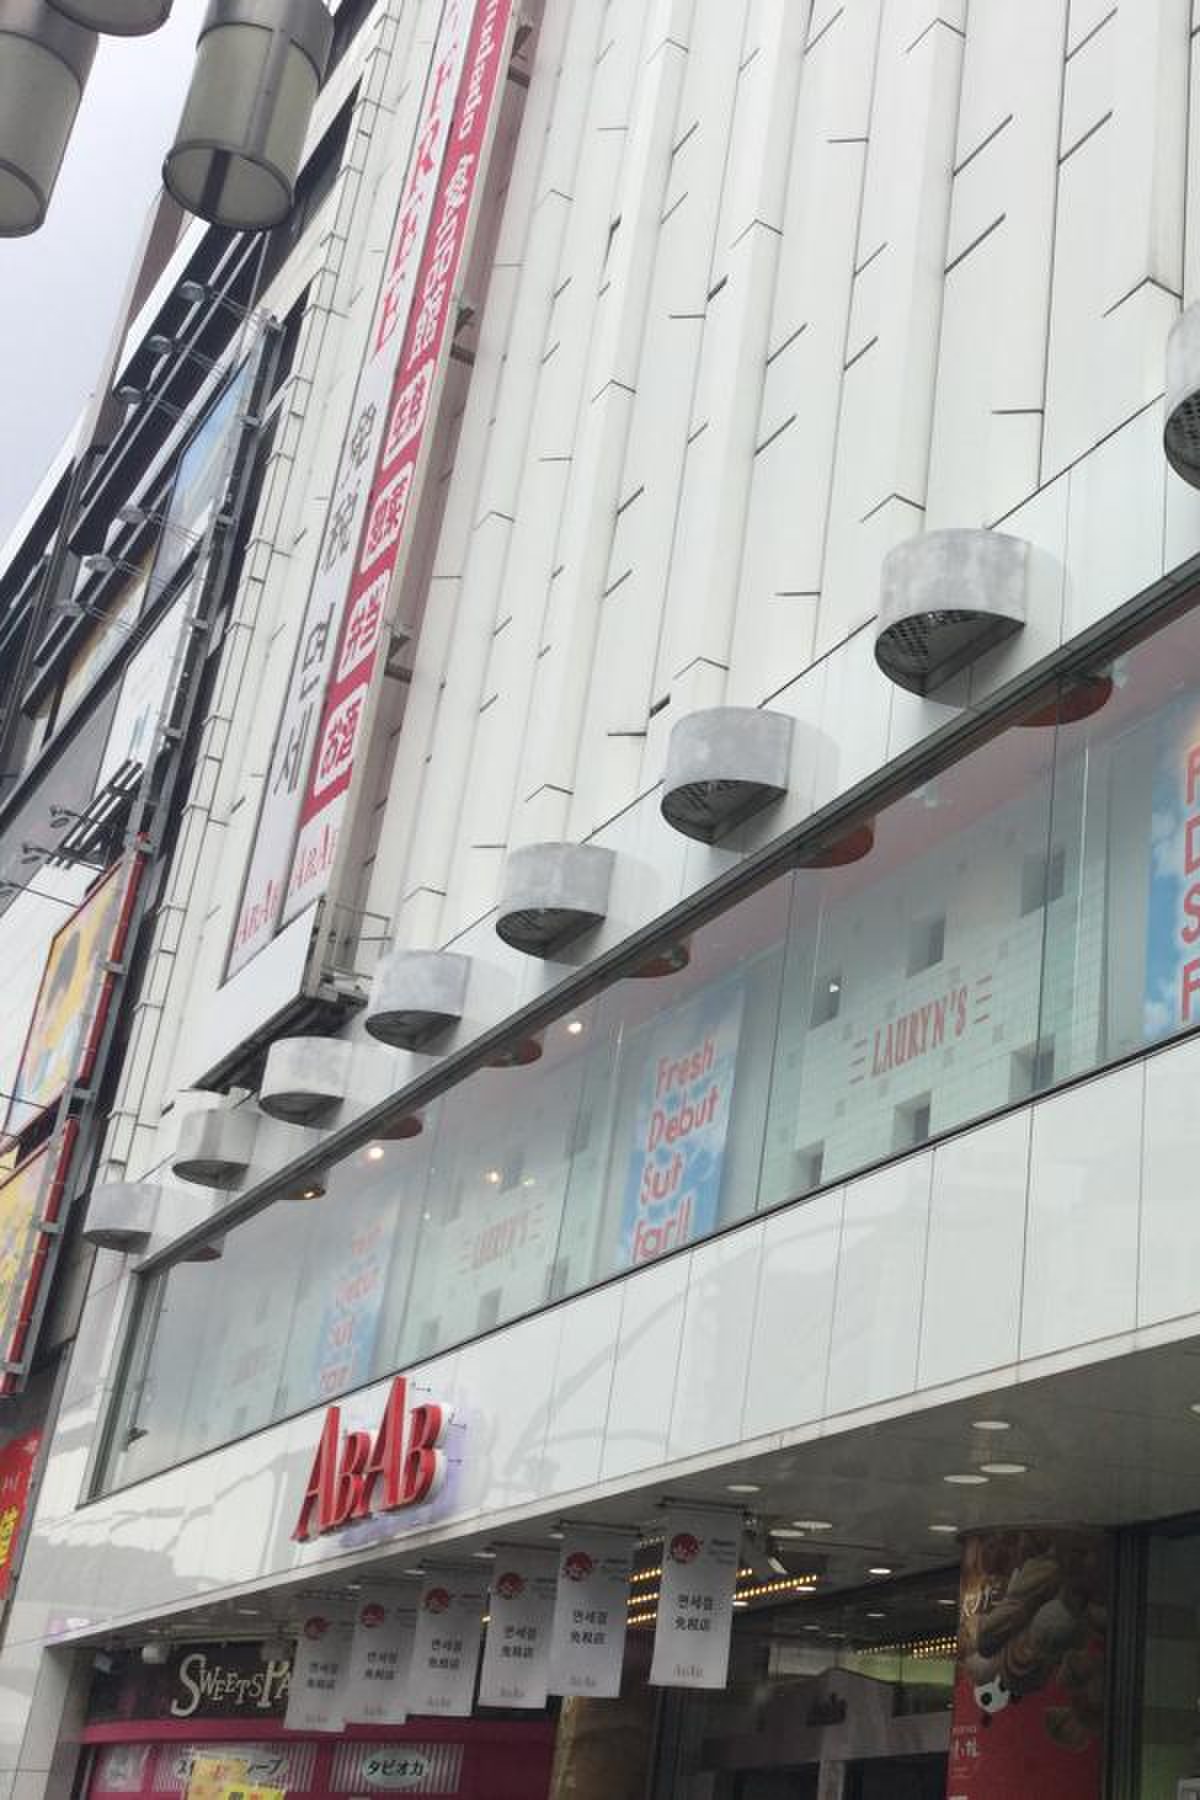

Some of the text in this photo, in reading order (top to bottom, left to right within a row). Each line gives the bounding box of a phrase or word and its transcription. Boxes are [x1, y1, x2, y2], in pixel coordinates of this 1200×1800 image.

[872, 985, 968, 1077] LAURYN'S
[656, 1038, 715, 1101] Fresh
[648, 1086, 719, 1153] Debut
